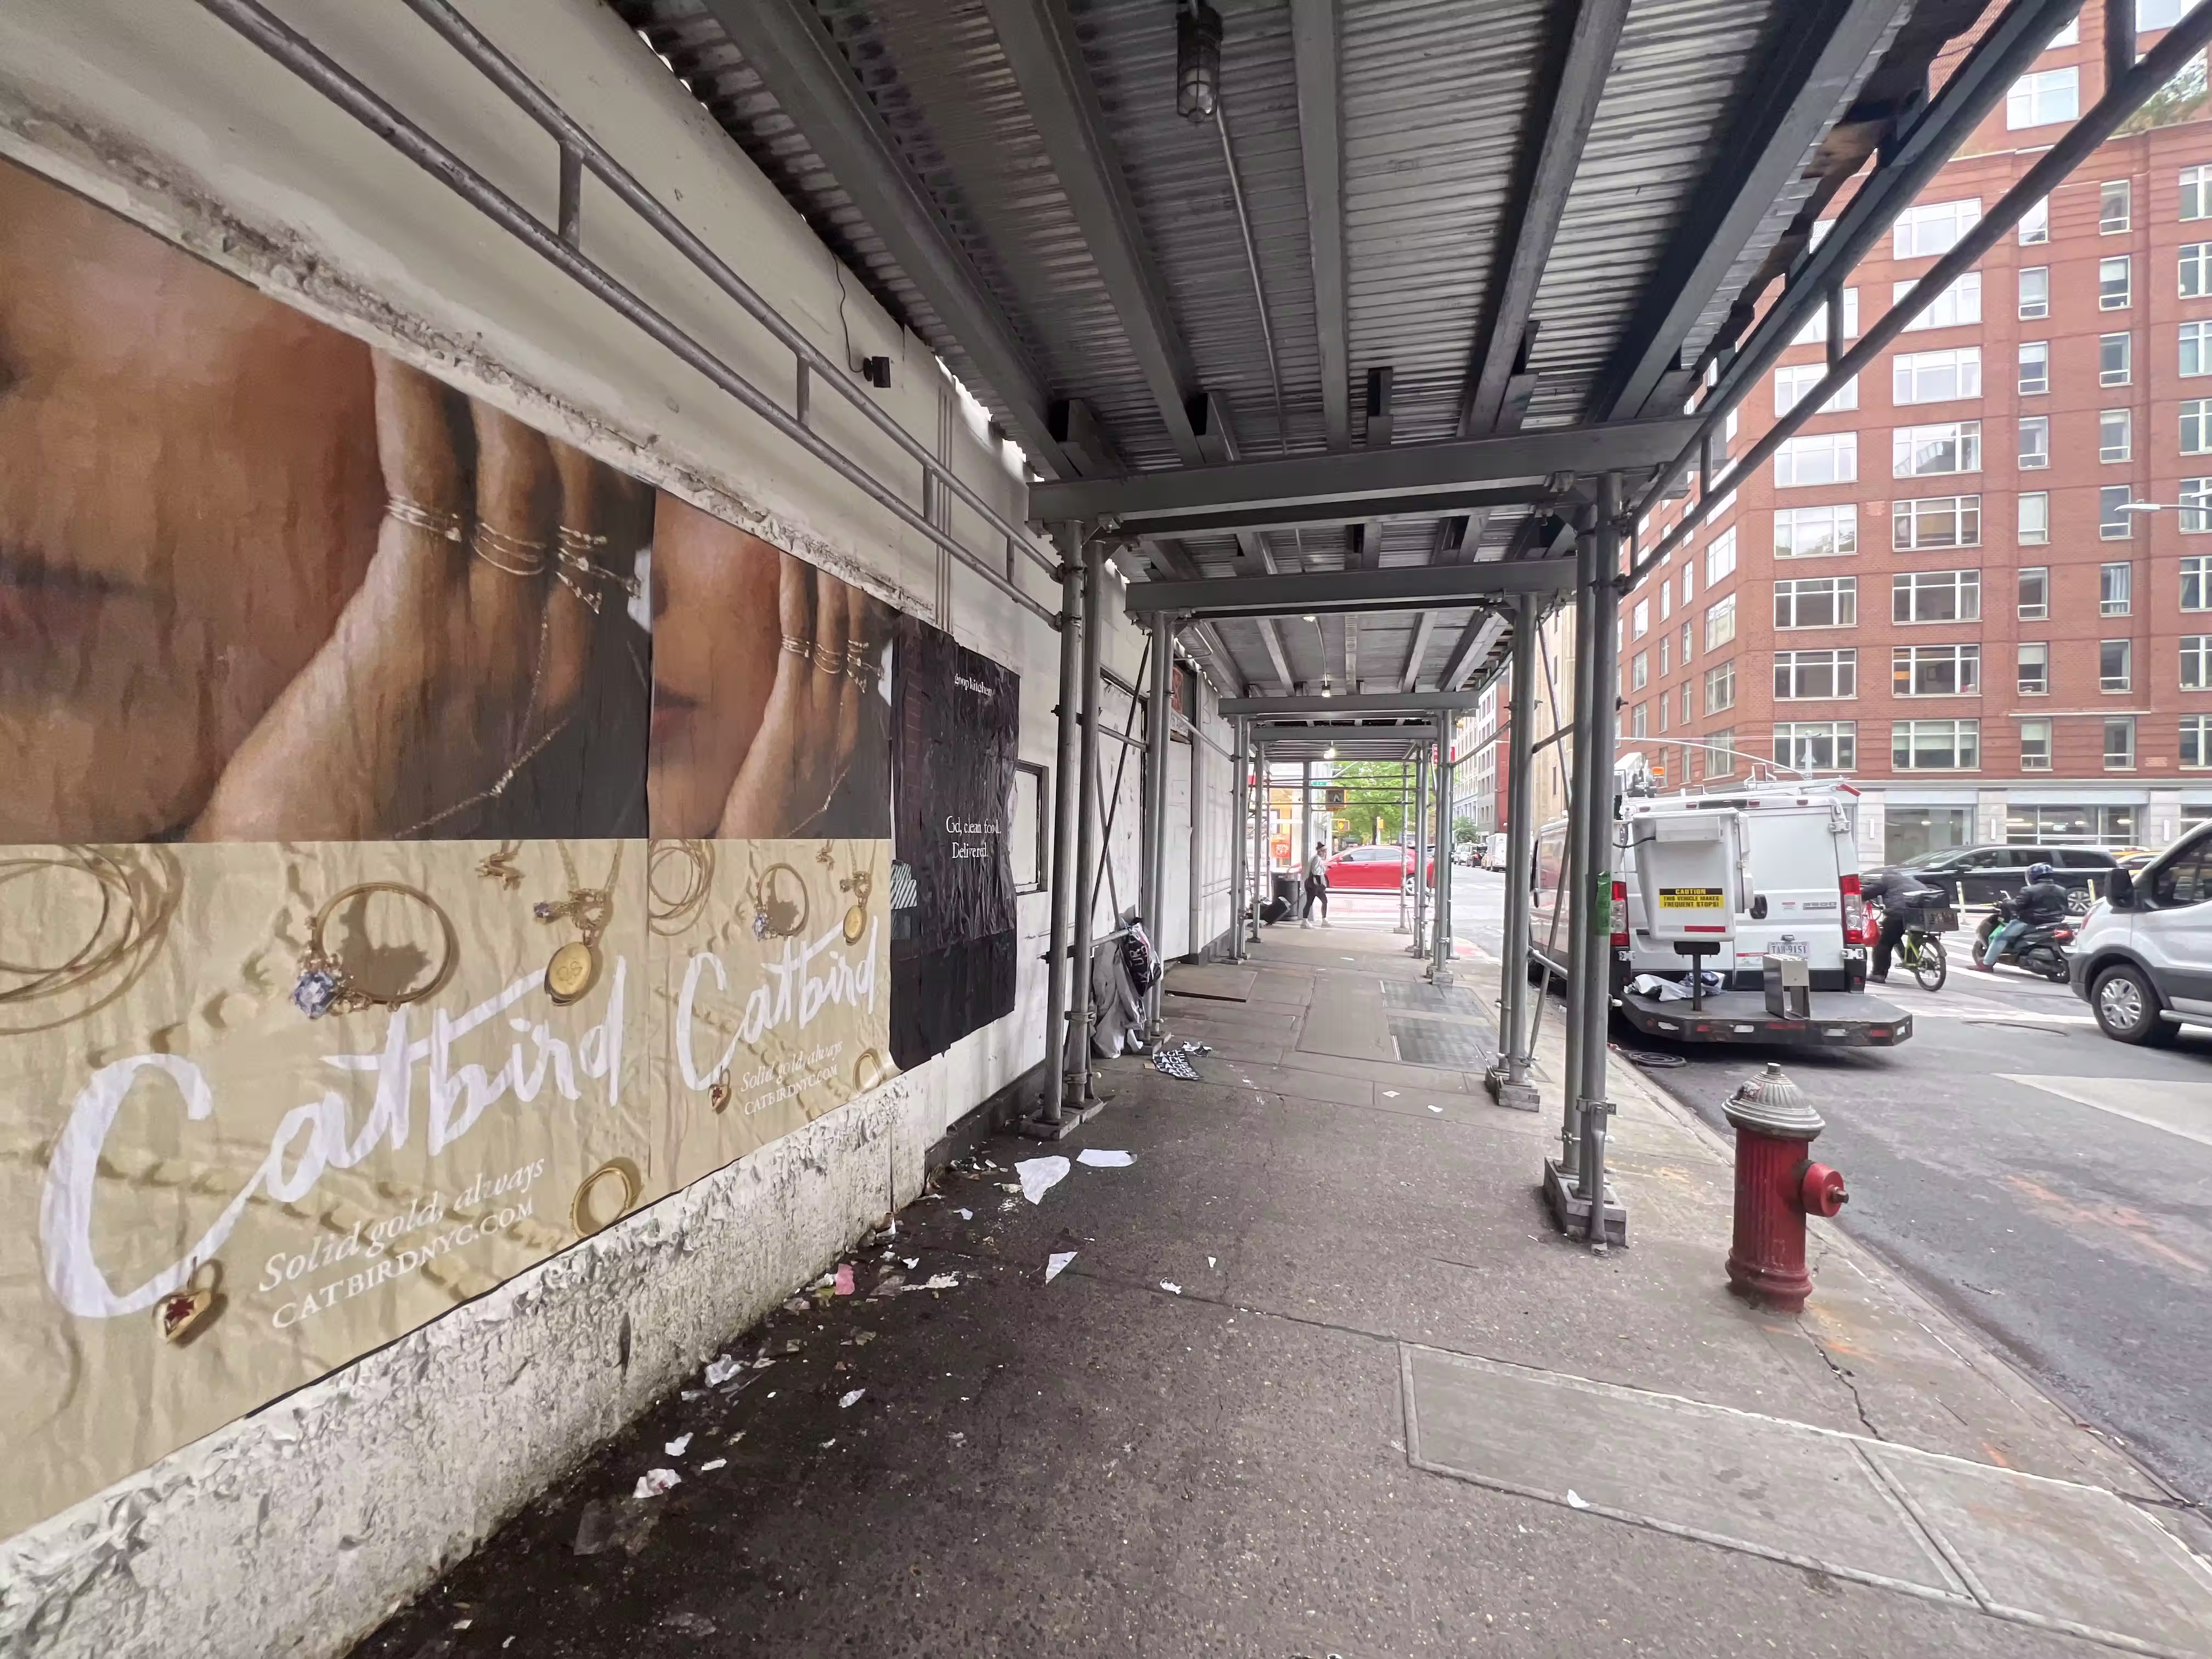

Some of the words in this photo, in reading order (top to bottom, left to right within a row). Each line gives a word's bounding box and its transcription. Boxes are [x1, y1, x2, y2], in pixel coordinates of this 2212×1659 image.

[952, 842, 989, 859] Delivered.
[963, 814, 982, 833] clean
[675, 915, 878, 1091] Catbird
[741, 1061, 775, 1092] Solid
[807, 1040, 843, 1065] always
[744, 1064, 838, 1115] CATBIRDNYC.COM
[40, 954, 627, 1317] Catbird
[258, 1220, 362, 1293] Solid
[364, 1190, 444, 1260] gold,
[453, 1158, 545, 1212] always
[272, 1195, 534, 1329] CATBIRDNYC.COM
